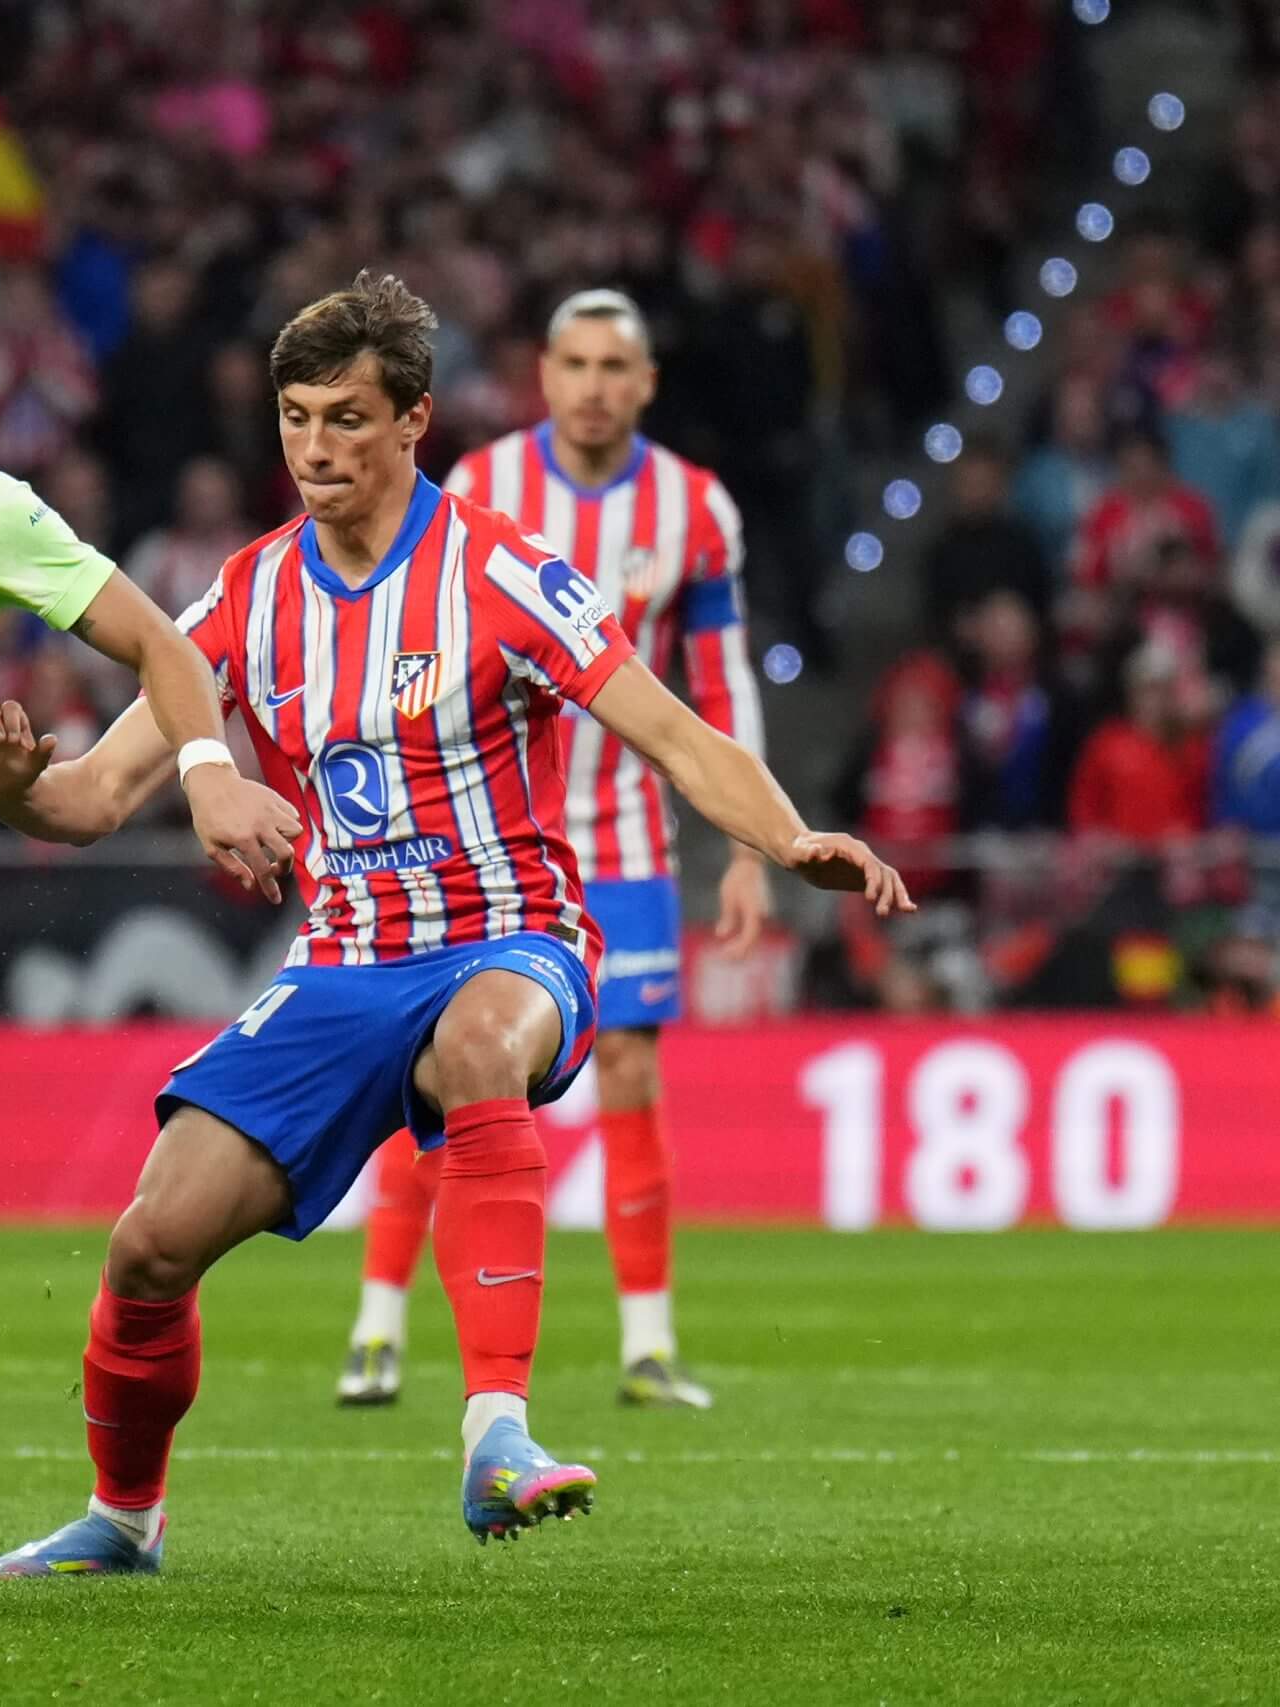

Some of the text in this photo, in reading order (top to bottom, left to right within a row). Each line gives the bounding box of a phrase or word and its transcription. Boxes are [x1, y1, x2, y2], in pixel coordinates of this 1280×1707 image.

[323, 836, 449, 875] RIYADH AIR
[236, 983, 299, 1038] 4
[797, 1038, 1183, 1232] 180
